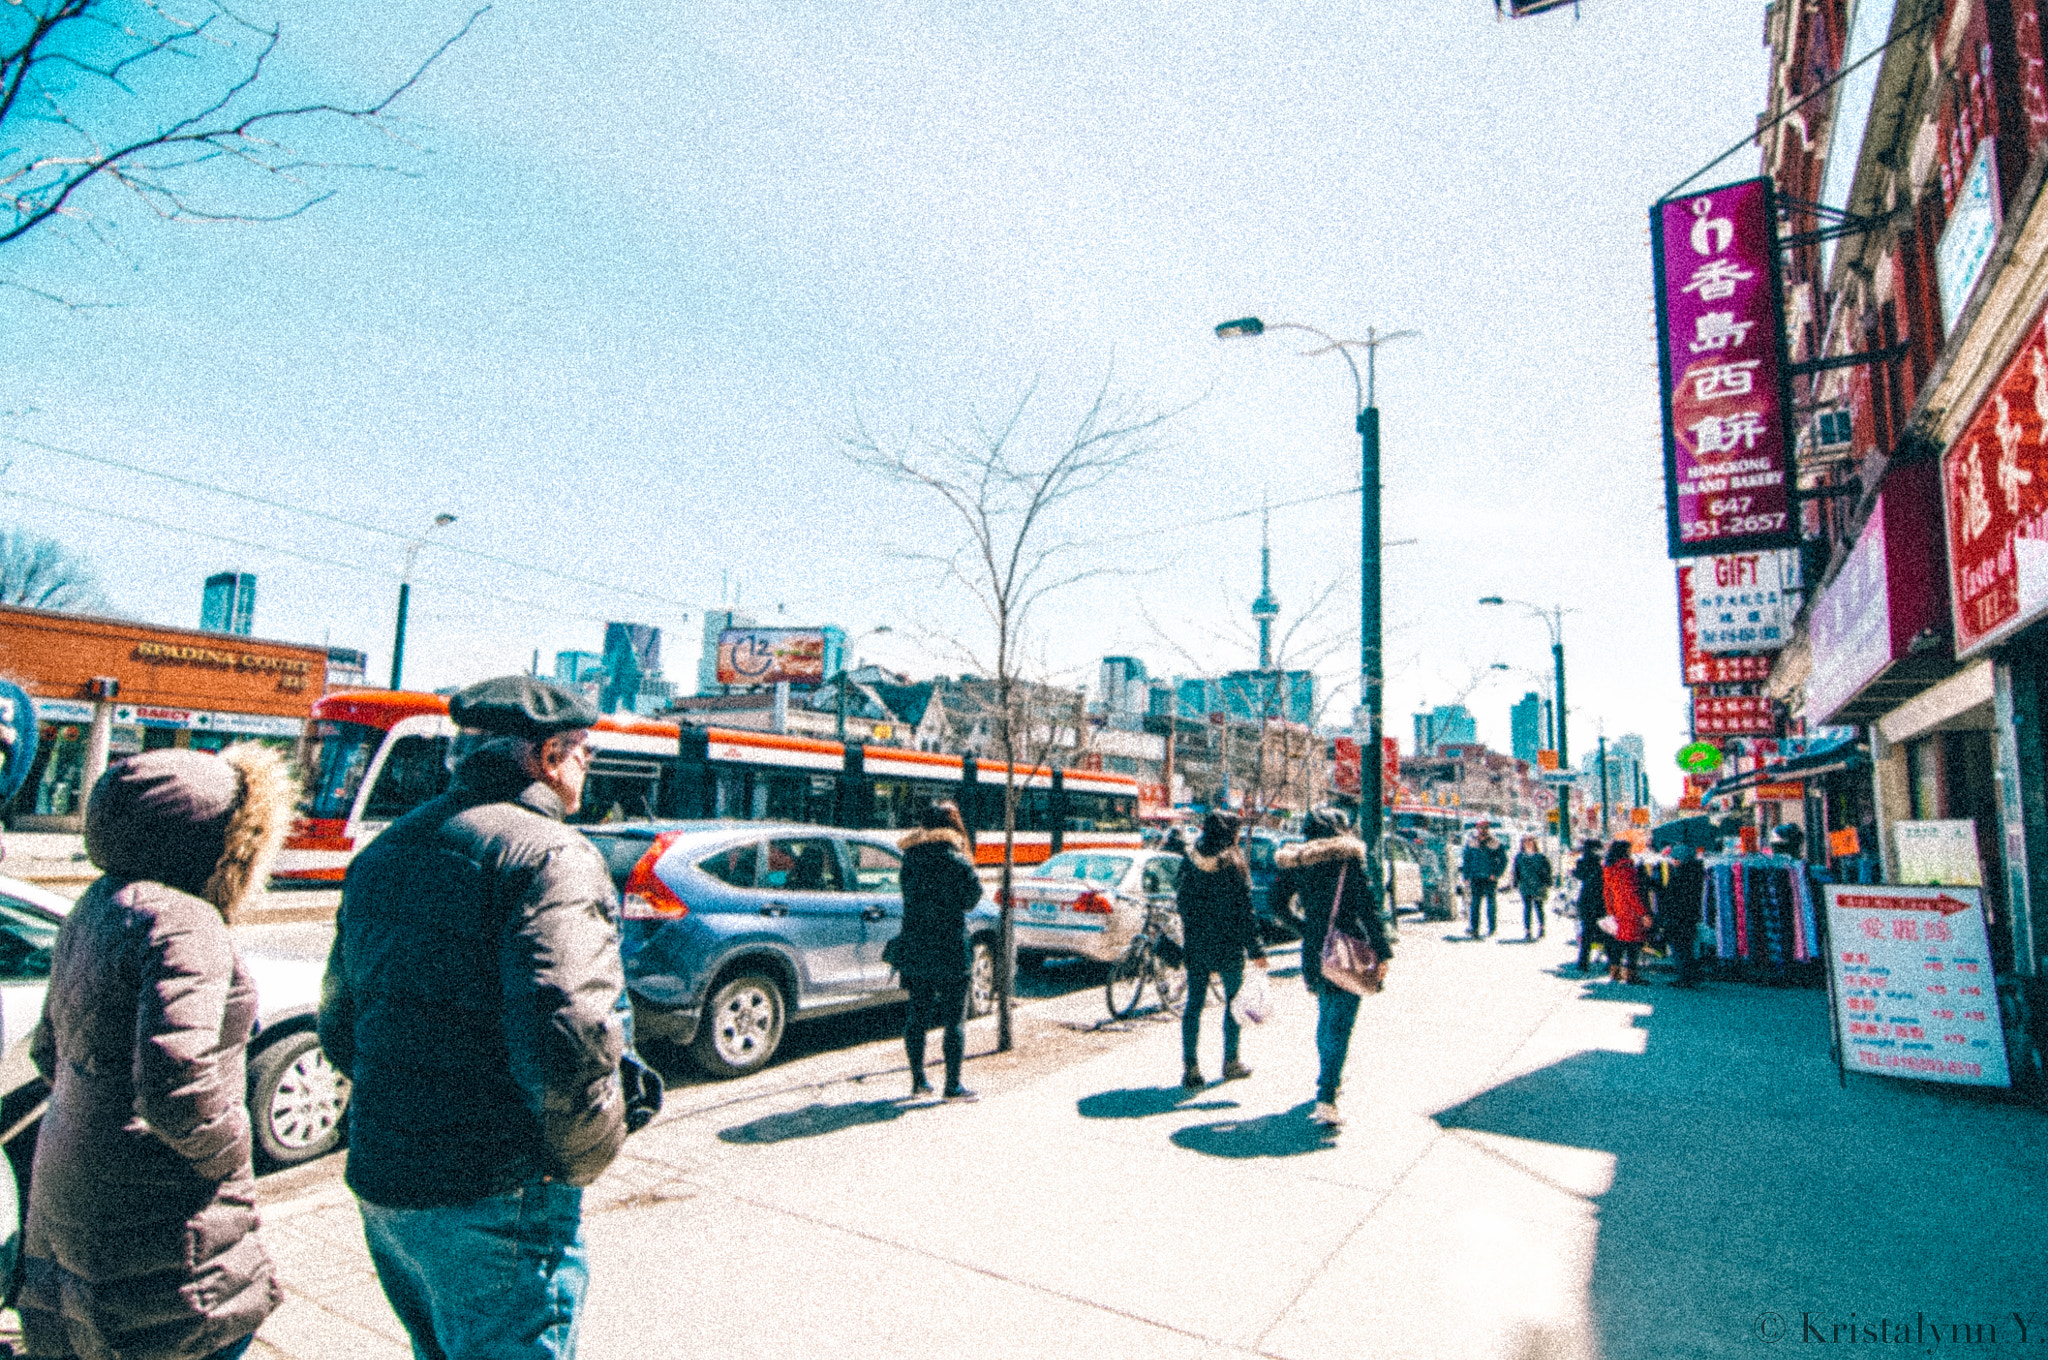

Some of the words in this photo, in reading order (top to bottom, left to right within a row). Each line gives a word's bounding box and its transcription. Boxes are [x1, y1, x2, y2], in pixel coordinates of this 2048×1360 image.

[1681, 257, 1767, 456] 香島西餅
[1687, 457, 1771, 479] HONGKONG
[1678, 478, 1727, 496] ISLAND
[1730, 471, 1784, 489] BAKERY
[1709, 496, 1753, 516] 647
[1714, 556, 1759, 588] GIFT
[137, 641, 236, 666] SPADINA
[241, 654, 311, 673] COURT
